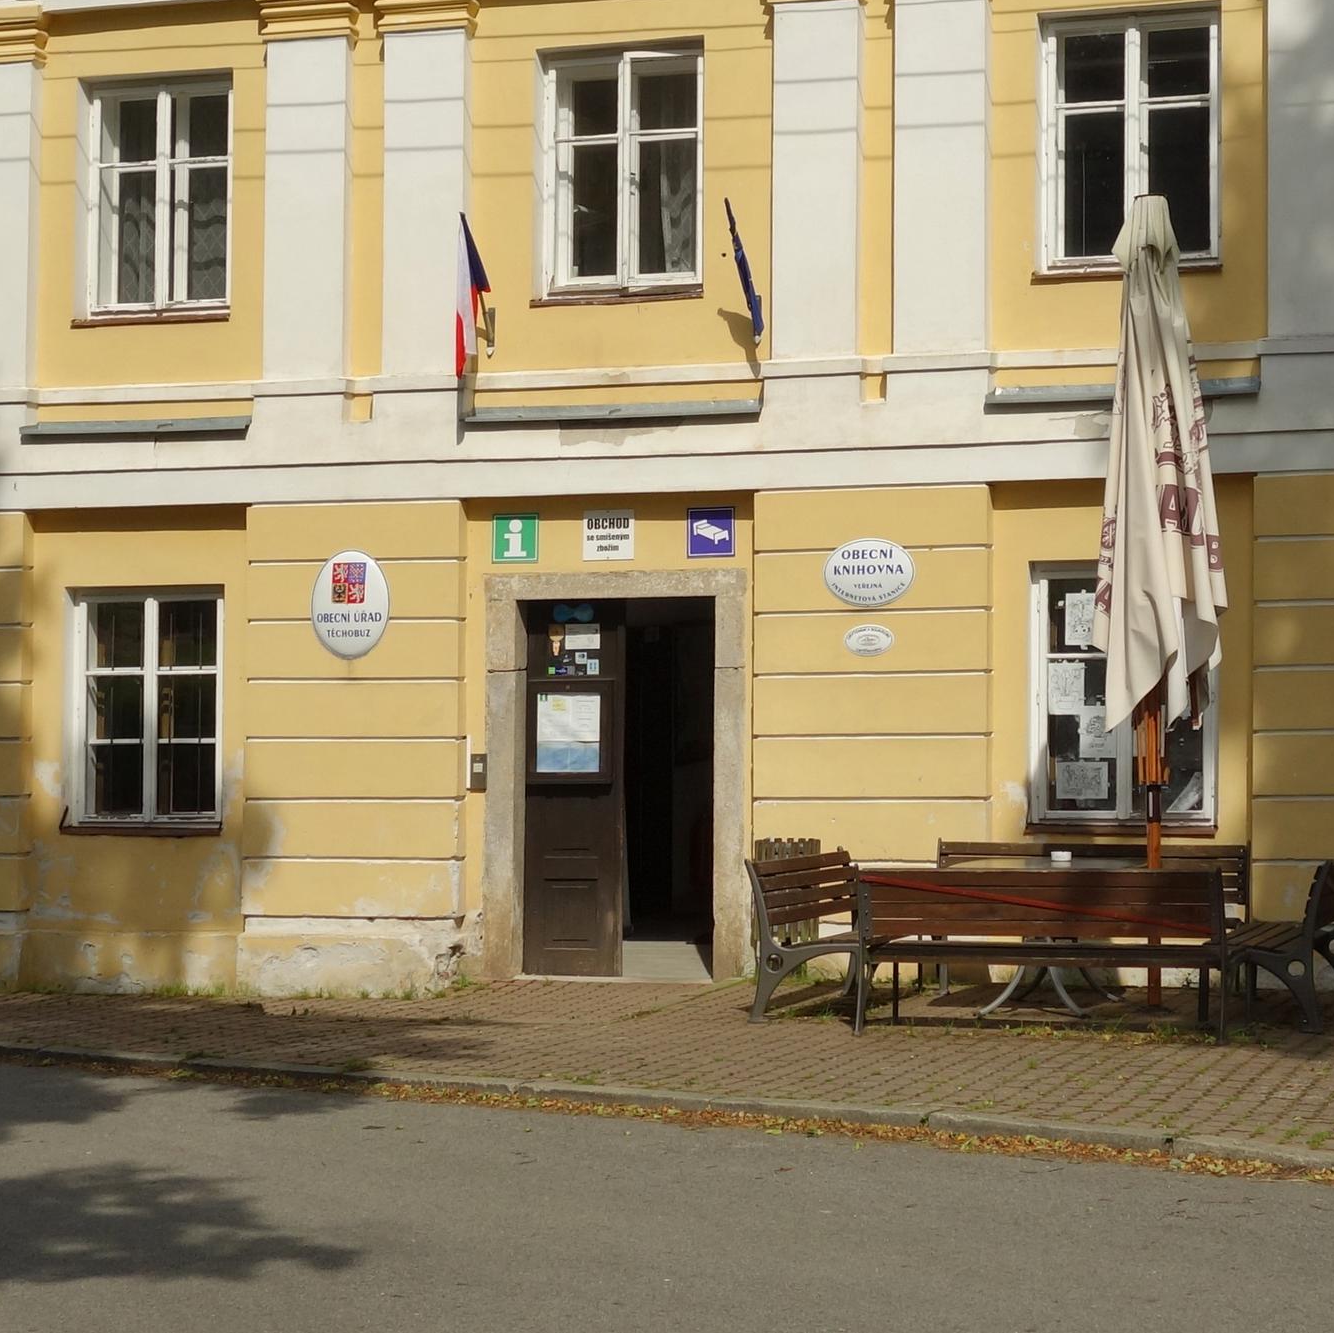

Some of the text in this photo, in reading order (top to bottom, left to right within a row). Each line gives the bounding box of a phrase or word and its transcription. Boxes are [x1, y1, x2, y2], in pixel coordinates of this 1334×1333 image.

[587, 518, 630, 530] OBCHOD
[841, 546, 893, 560] OBECNÍ
[833, 564, 904, 576] KNIHOVNA
[878, 582, 906, 601] STANICE
[317, 611, 382, 623] OBECNÍ ÚŘAD
[327, 628, 371, 638] TĚCHOBUZ
